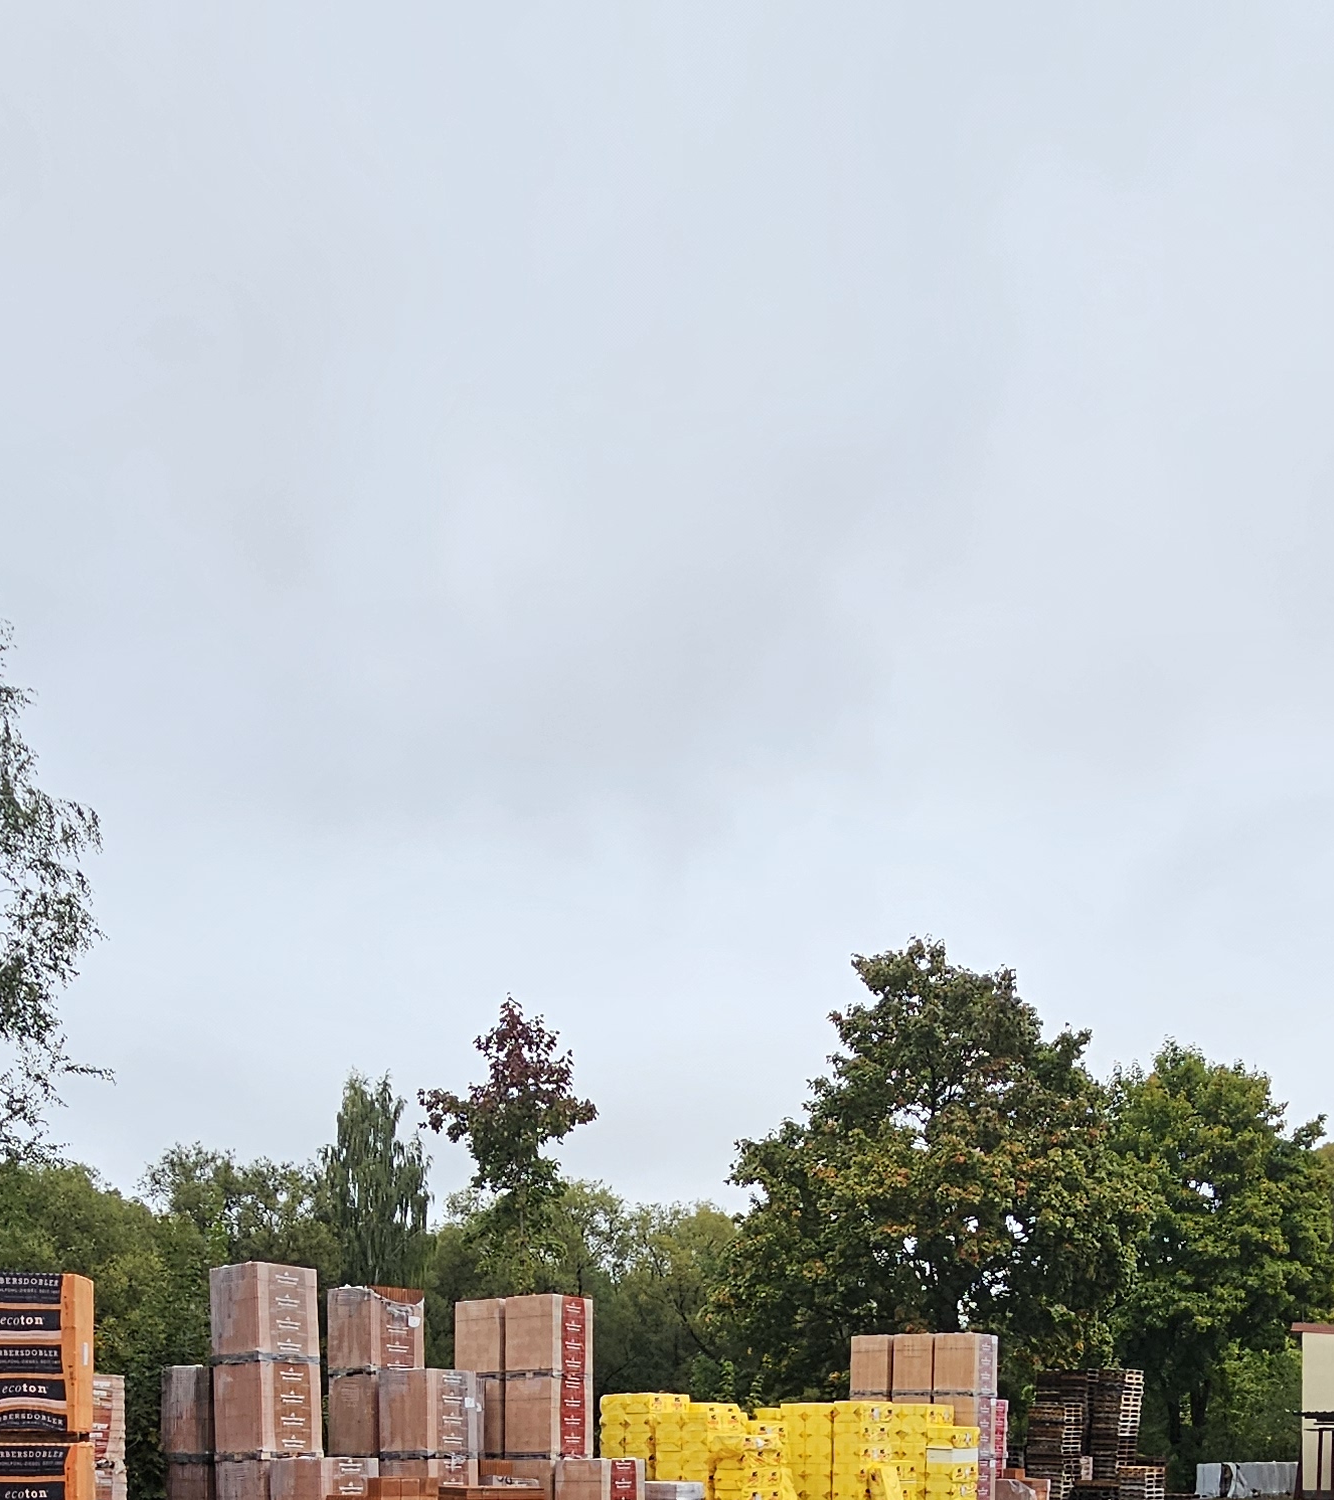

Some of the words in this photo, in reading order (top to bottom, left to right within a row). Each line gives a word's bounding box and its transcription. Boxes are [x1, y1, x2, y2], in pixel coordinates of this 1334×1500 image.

[0, 1315, 44, 1326] ecoton
[1, 1383, 47, 1394] ecoton
[4, 1488, 48, 1499] ecoton
